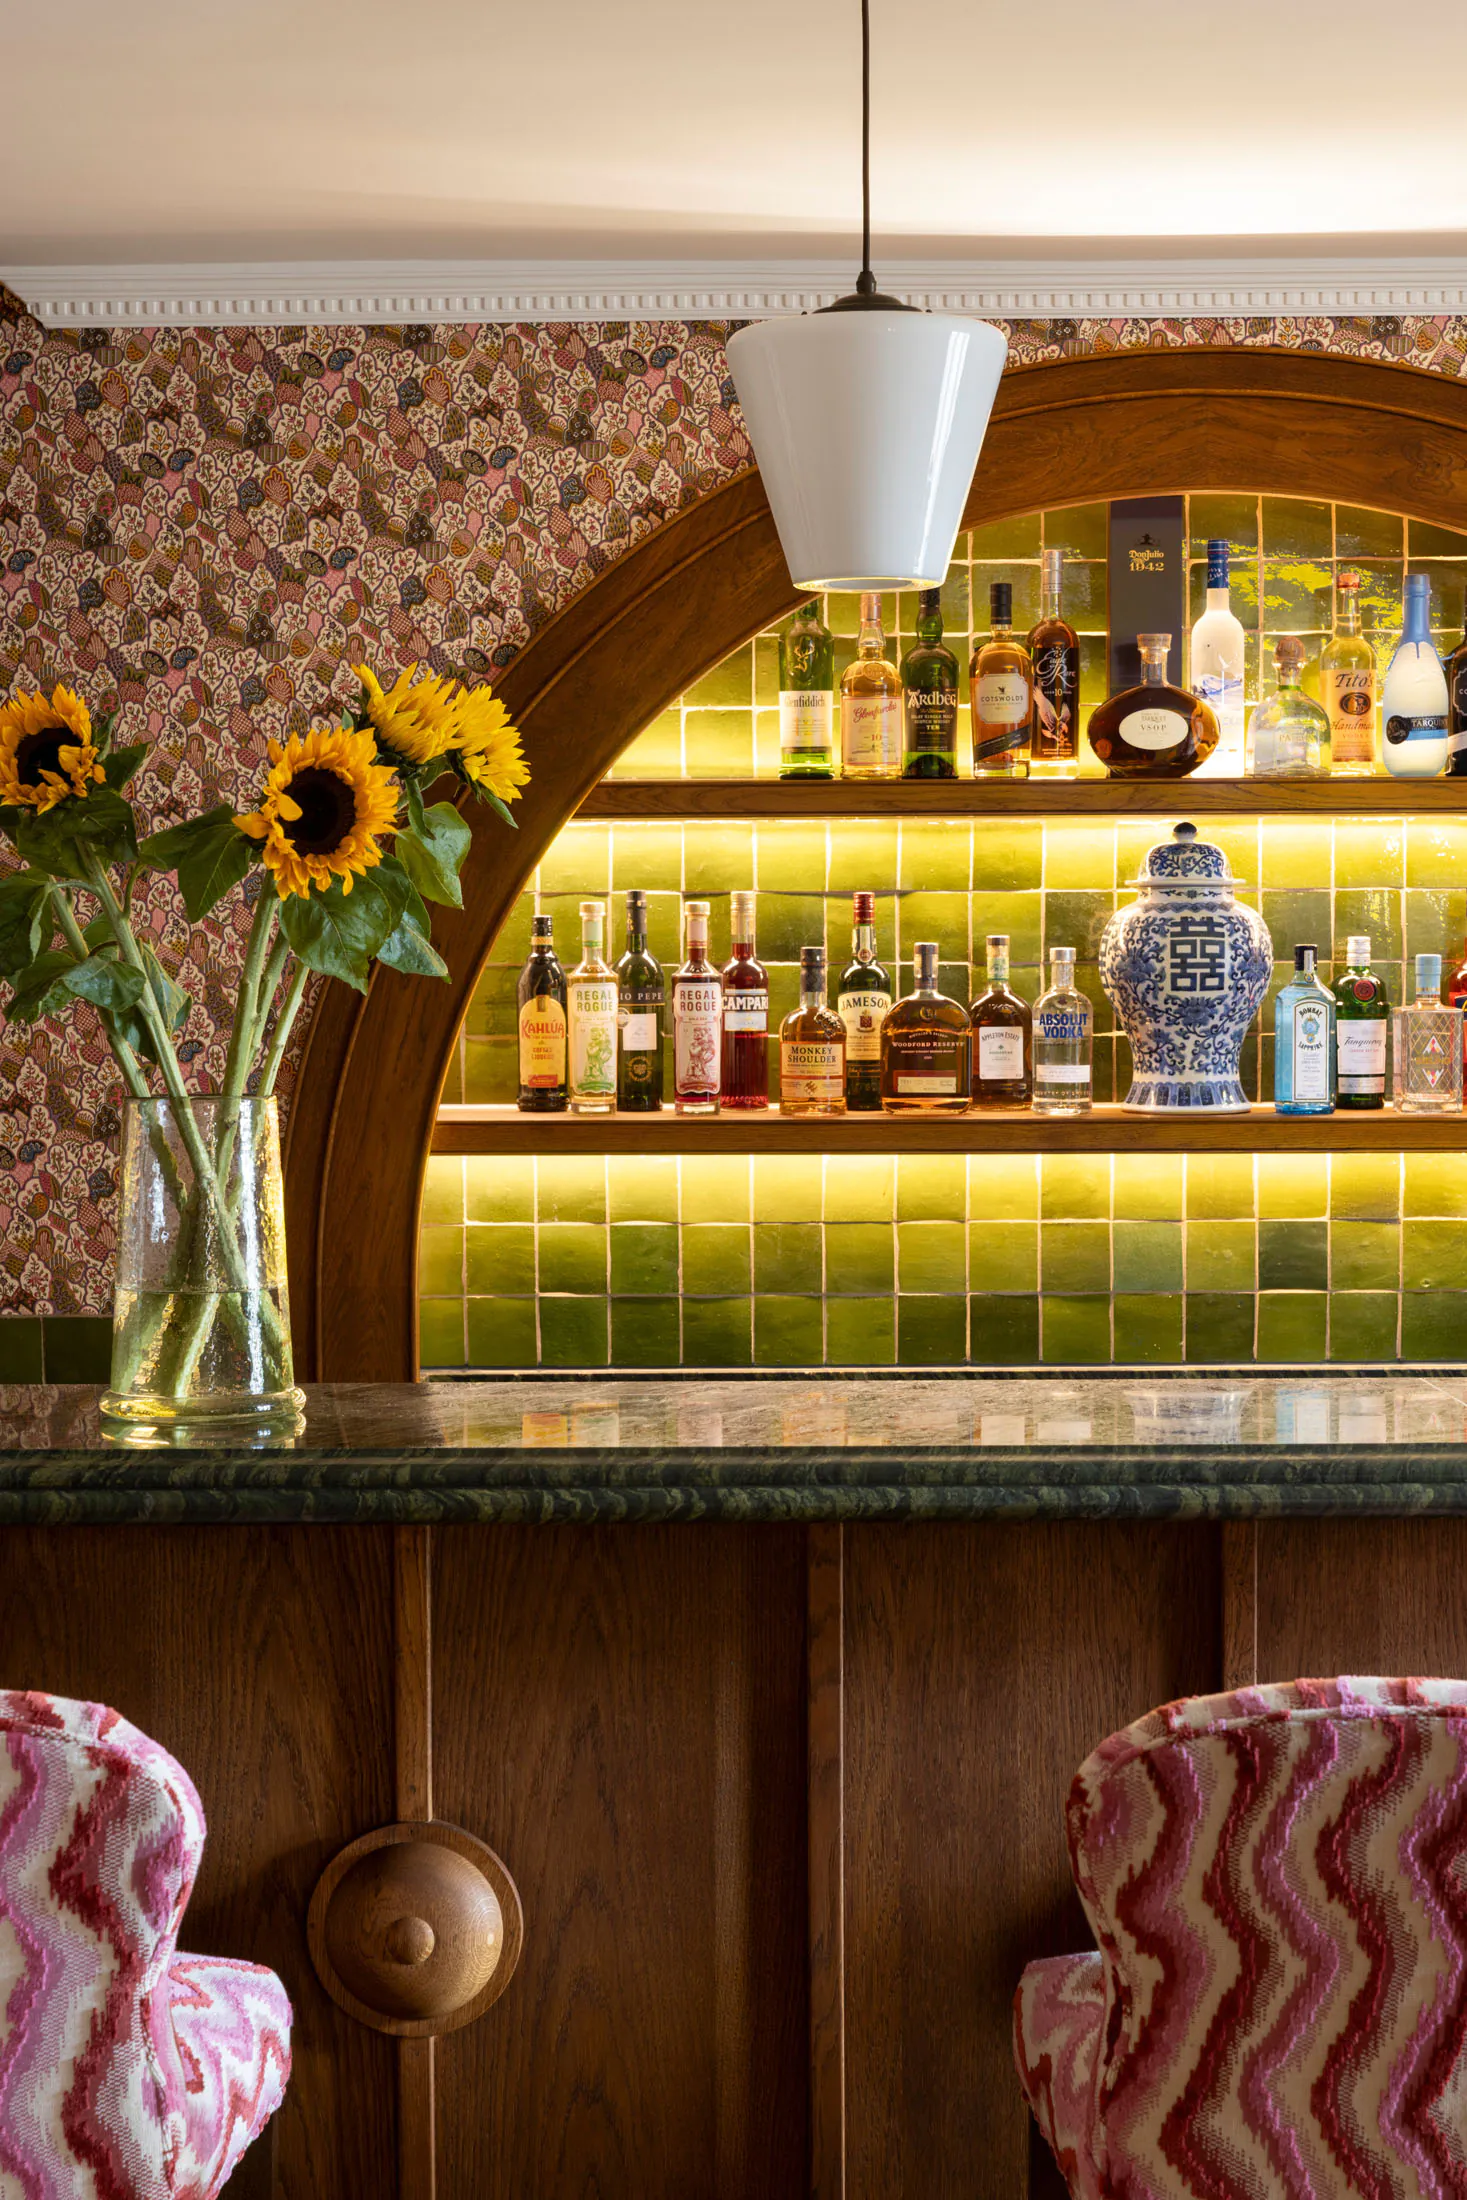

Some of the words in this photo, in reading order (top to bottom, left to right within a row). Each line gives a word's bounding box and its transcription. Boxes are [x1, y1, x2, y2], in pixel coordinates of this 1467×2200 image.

[1129, 560, 1165, 572] 1942
[1335, 671, 1374, 688] Tito's
[1054, 688, 1063, 697] 10
[907, 688, 956, 709] Ardbeg
[576, 990, 613, 1000] REGAL
[620, 992, 632, 1000] IO
[638, 992, 664, 1000] PEPE
[680, 990, 717, 1000] REGAL
[577, 1002, 613, 1012] ROGUE
[680, 1002, 717, 1011] ROGUE
[842, 997, 889, 1011] JAMESON
[1298, 1007, 1323, 1018] BOMBAY
[1039, 1013, 1088, 1026] ABSOLUT
[521, 1019, 565, 1039] KAHLÚA
[1043, 1026, 1084, 1039] VODKA
[981, 1032, 1004, 1042] APPLETON
[1004, 1031, 1020, 1042] ESTATE
[1344, 1036, 1383, 1047] Tanqueray
[791, 1046, 833, 1055] MONKEY
[1297, 1041, 1324, 1051] SAPPHIRE
[787, 1055, 837, 1063] SHOULDER
